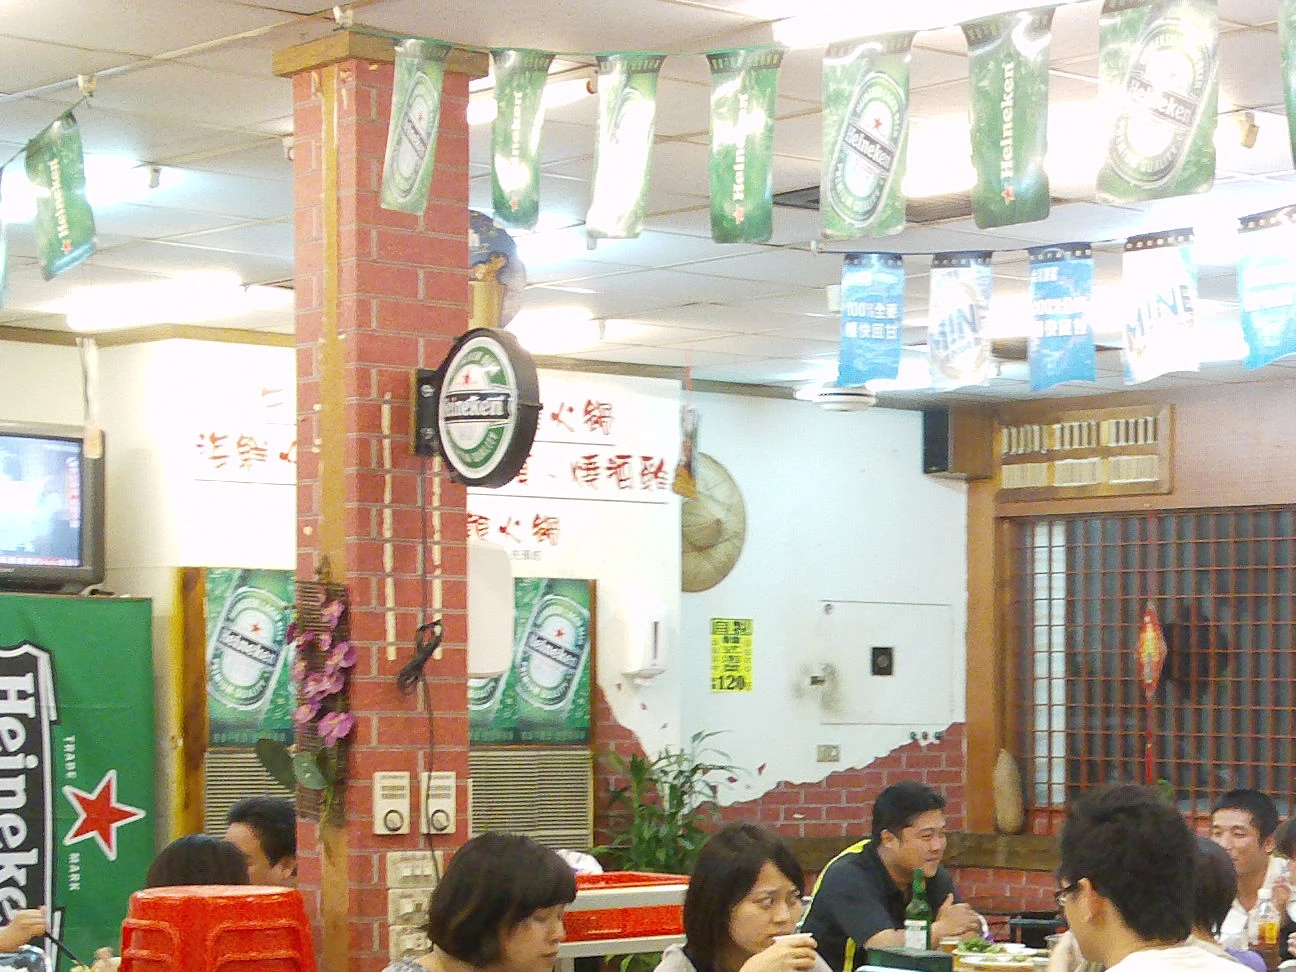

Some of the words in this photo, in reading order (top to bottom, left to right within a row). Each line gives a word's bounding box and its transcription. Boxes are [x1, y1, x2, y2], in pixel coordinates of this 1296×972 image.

[1001, 60, 1014, 177] Heineken
[1127, 79, 1192, 126] Heeken
[732, 93, 747, 200] Heinn
[844, 125, 891, 172] Heineken
[63, 735, 77, 780] TRADE
[0, 671, 39, 923] Heineke
[68, 852, 81, 891] MARK
